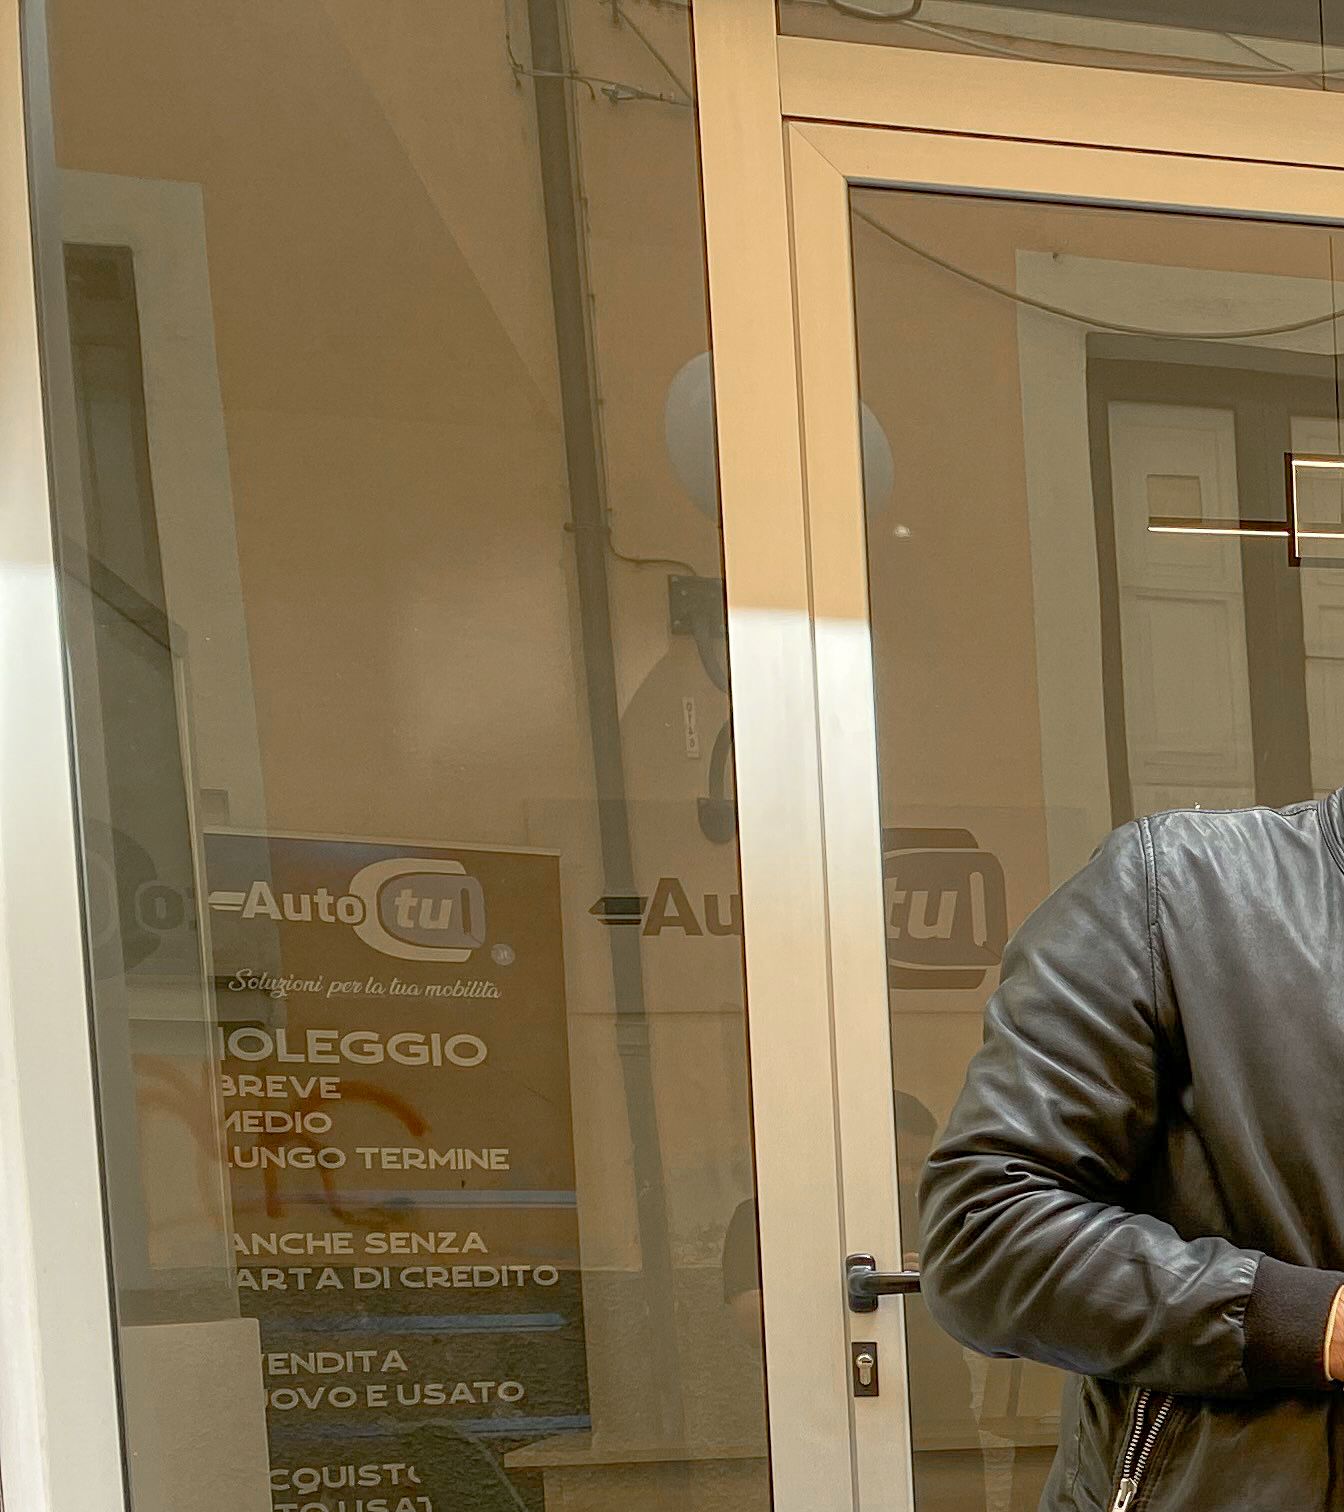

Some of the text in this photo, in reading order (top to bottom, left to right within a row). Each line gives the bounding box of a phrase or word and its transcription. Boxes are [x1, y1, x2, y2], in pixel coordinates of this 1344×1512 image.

[242, 881, 363, 924] Auto
[394, 888, 452, 929] tu
[229, 968, 322, 998] Soluzioni
[327, 979, 362, 998] per
[365, 977, 386, 993] la
[390, 978, 421, 996] tua
[228, 1146, 510, 1170] UNGO TERMINE
[365, 1232, 488, 1254] SENZA
[237, 1265, 559, 1291] ARTA DI CREDITO
[262, 1349, 408, 1375] ENDITA
[265, 1381, 525, 1411] OVO E USATO
[270, 1463, 422, 1495] CQUIST
